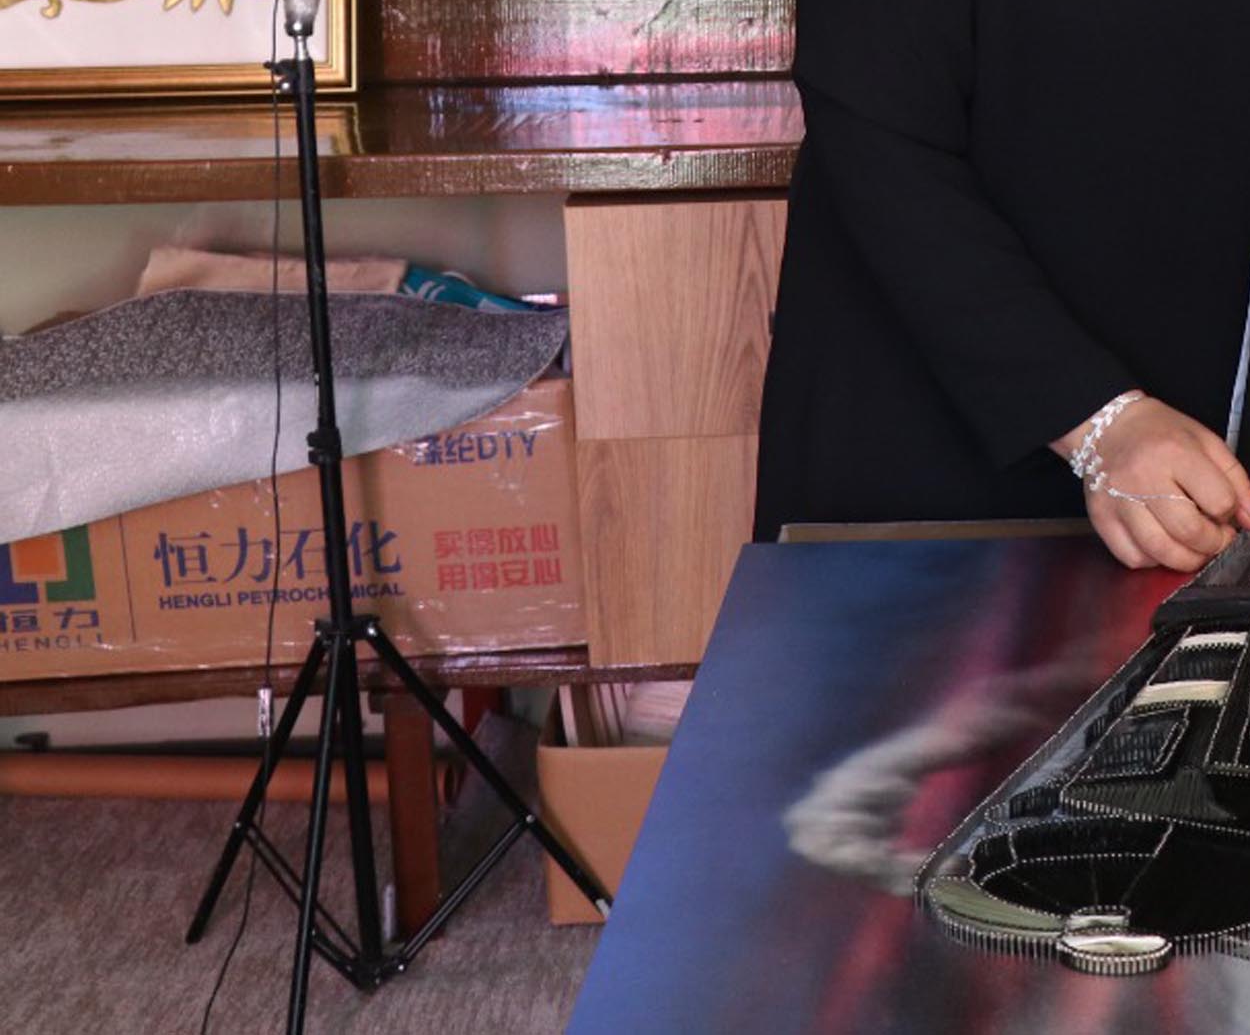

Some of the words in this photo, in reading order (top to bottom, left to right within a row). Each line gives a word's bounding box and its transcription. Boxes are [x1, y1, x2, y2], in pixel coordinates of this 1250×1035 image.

[154, 520, 403, 587] 恒力石化
[159, 592, 232, 611] HENGLI
[237, 581, 405, 606] PETROCHMICAL
